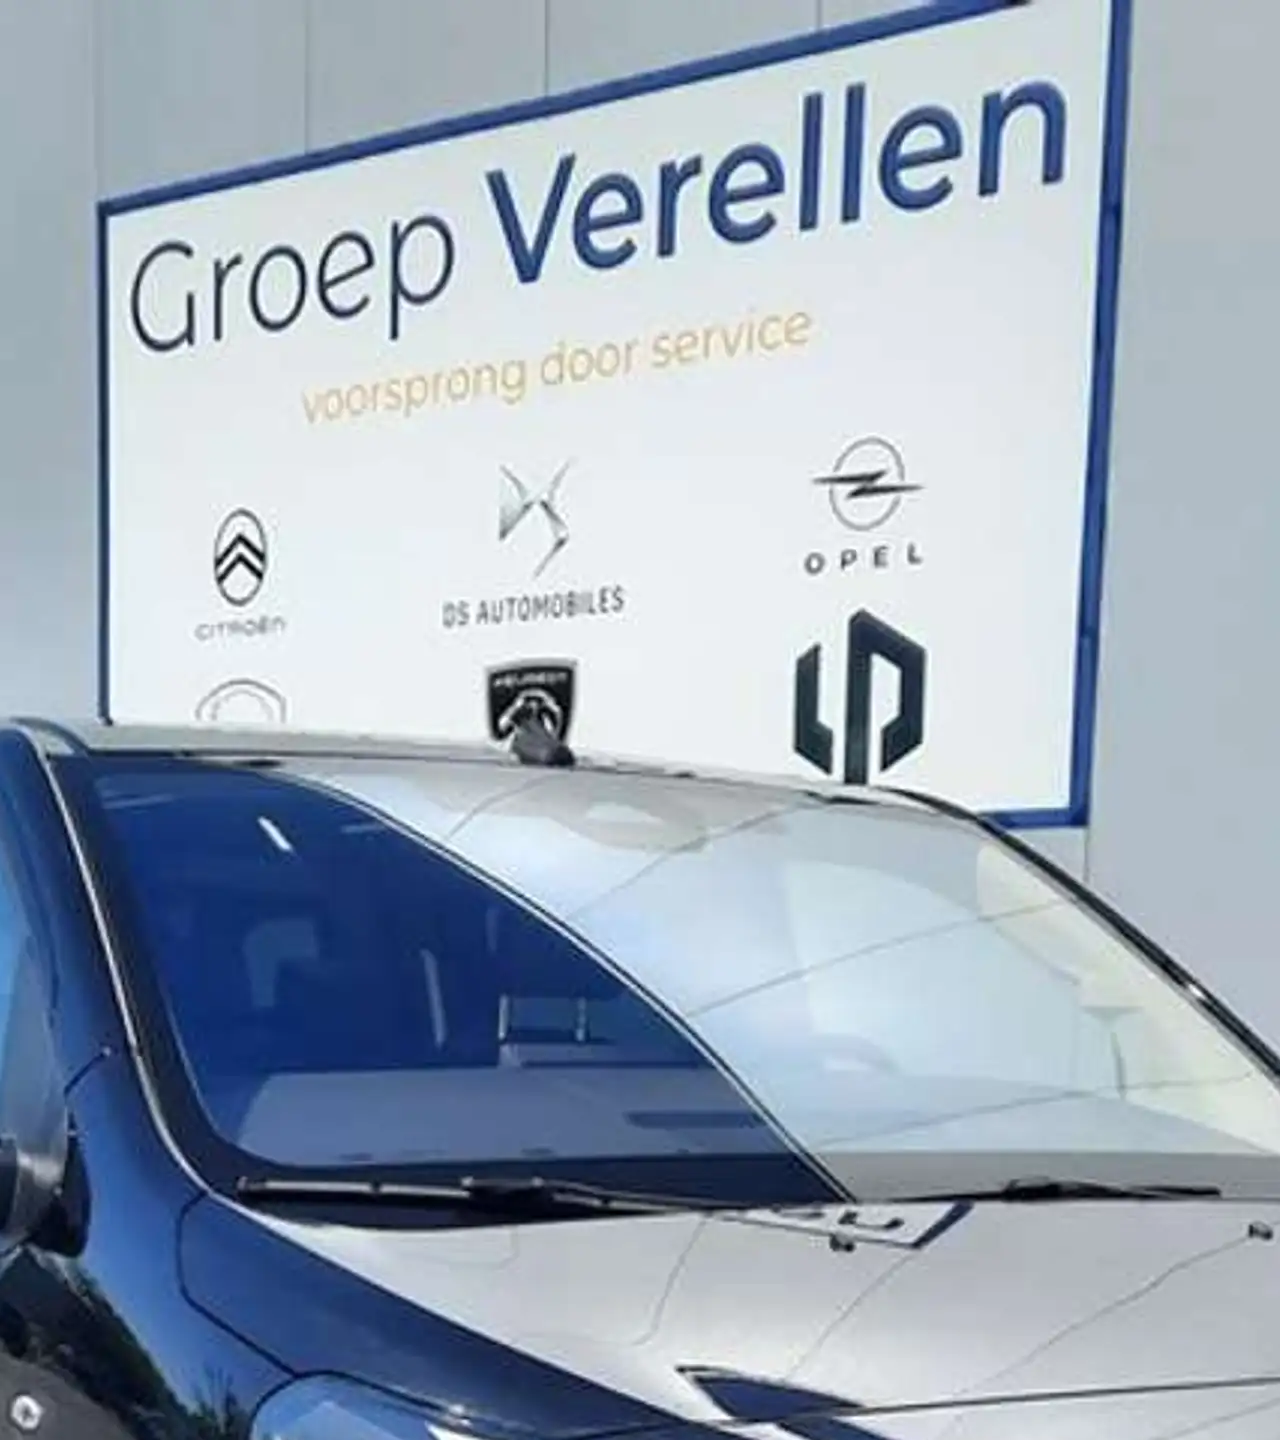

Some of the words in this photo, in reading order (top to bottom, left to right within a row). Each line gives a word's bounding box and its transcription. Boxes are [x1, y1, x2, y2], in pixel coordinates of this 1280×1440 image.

[130, 214, 454, 352] Groep
[486, 79, 1066, 284] Verellen
[302, 350, 525, 424] voorsprong
[540, 332, 638, 385] door
[651, 307, 813, 370] service
[805, 543, 923, 574] OPEL
[442, 601, 470, 627] DS
[476, 585, 624, 624] AUTOMOBILES
